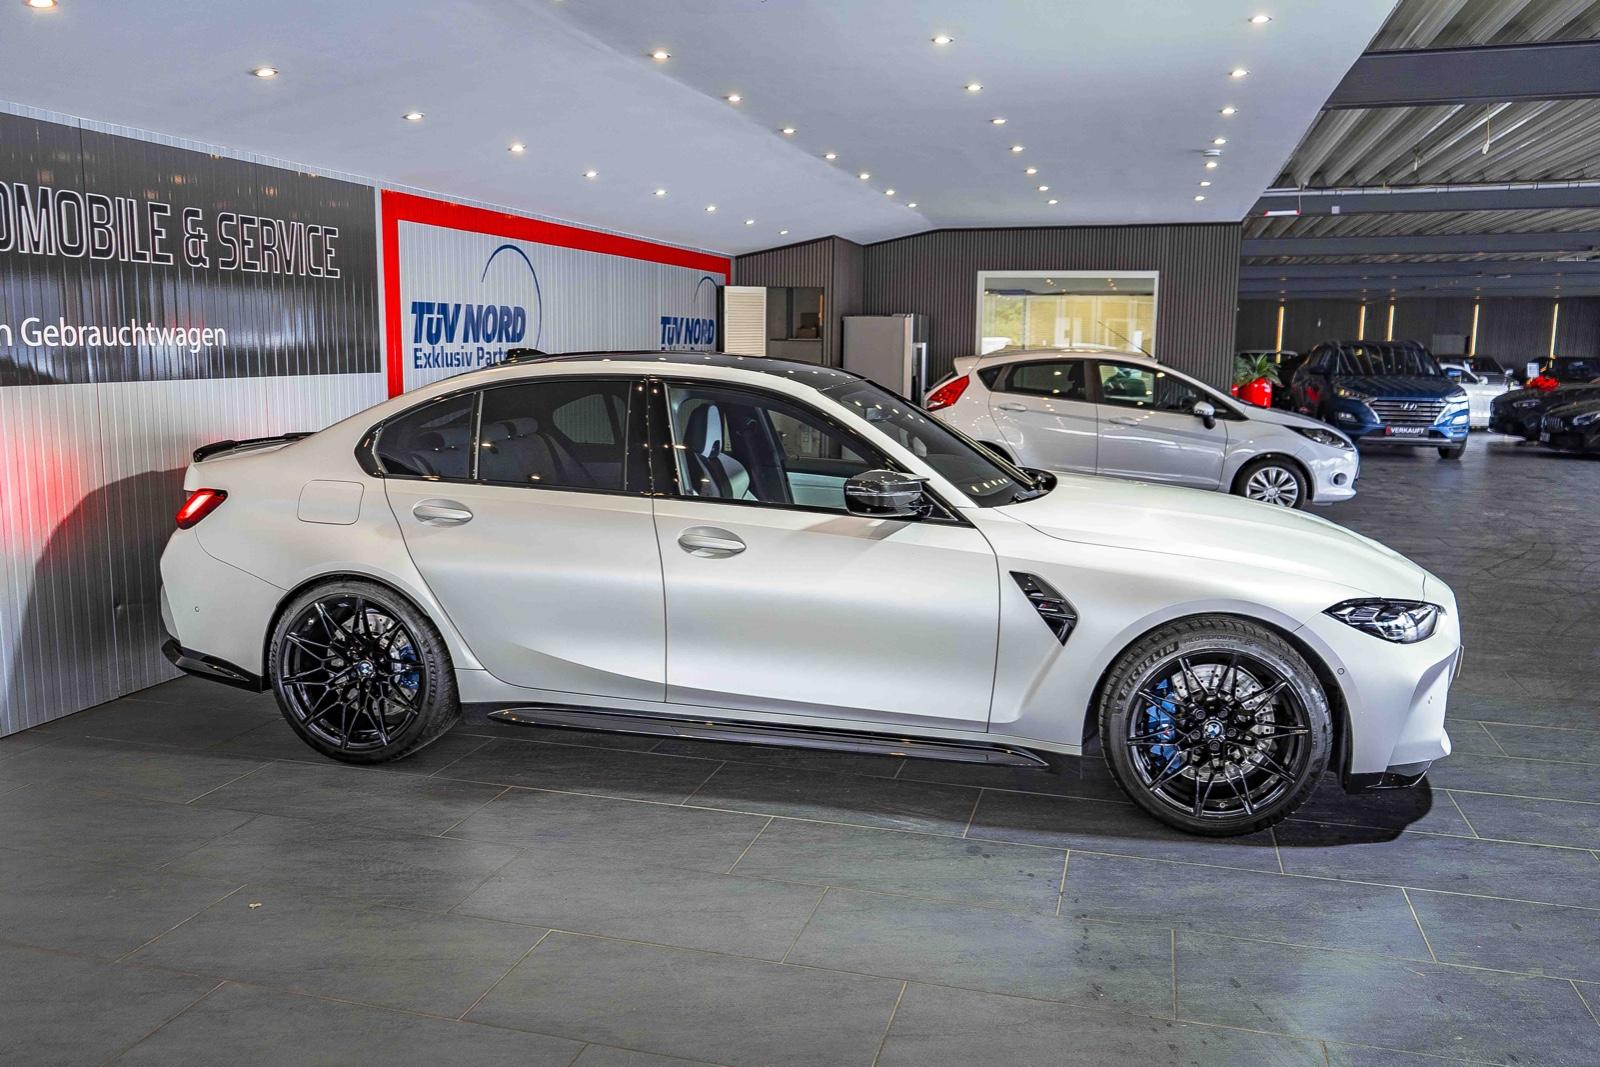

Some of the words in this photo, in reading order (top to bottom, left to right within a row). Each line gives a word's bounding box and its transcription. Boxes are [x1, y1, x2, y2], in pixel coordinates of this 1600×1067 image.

[183, 207, 209, 268] &
[217, 212, 340, 279] SERVICE
[20, 316, 226, 353] Gebrauchtwagen
[411, 301, 462, 345] TÜV
[463, 304, 526, 343] NORD
[661, 316, 683, 346] TÜV
[684, 317, 715, 345] NORD
[413, 346, 473, 369] Exklusiv
[1391, 427, 1425, 435] VERKAUFT
[1120, 642, 1177, 697] MICHELIN
